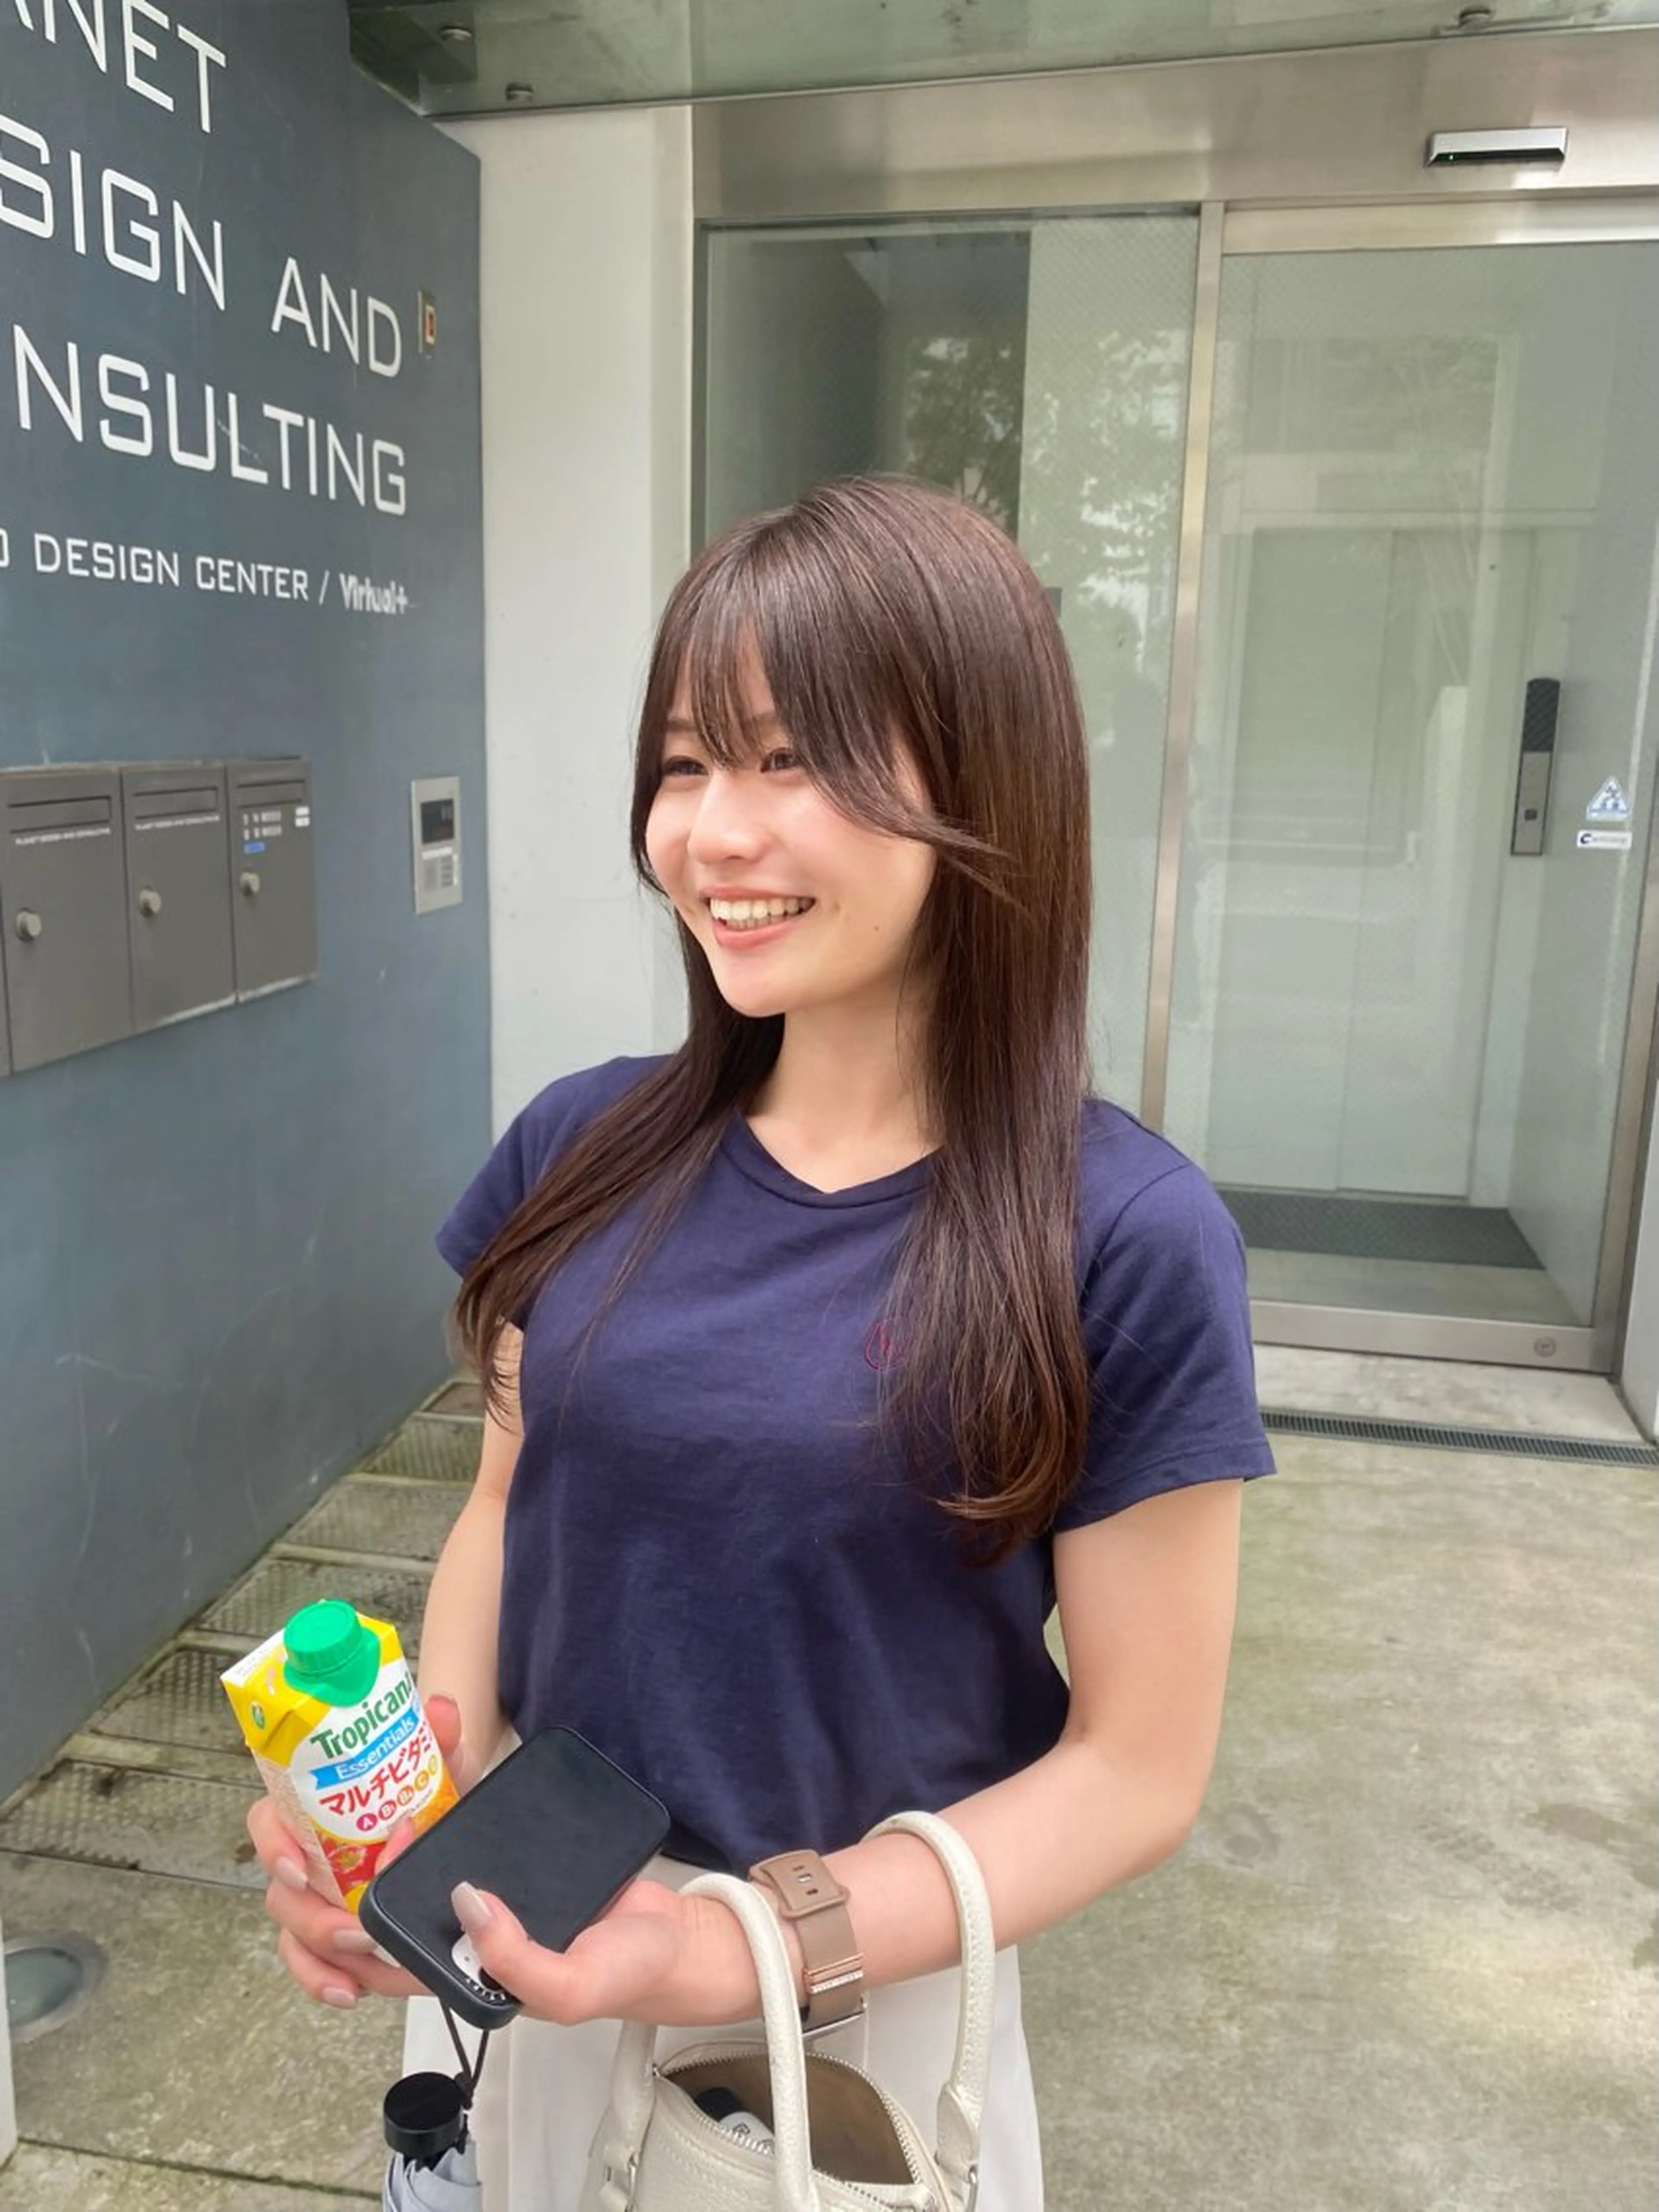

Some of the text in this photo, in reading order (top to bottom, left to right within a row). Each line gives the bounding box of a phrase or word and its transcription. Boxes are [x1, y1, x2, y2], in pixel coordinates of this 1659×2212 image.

[14, 0, 226, 133] NET
[271, 257, 401, 378] AND
[13, 324, 406, 516] NSULTING
[34, 532, 180, 587] DESIGN
[195, 555, 309, 602] CENTER
[335, 1716, 416, 1780] Essentials
